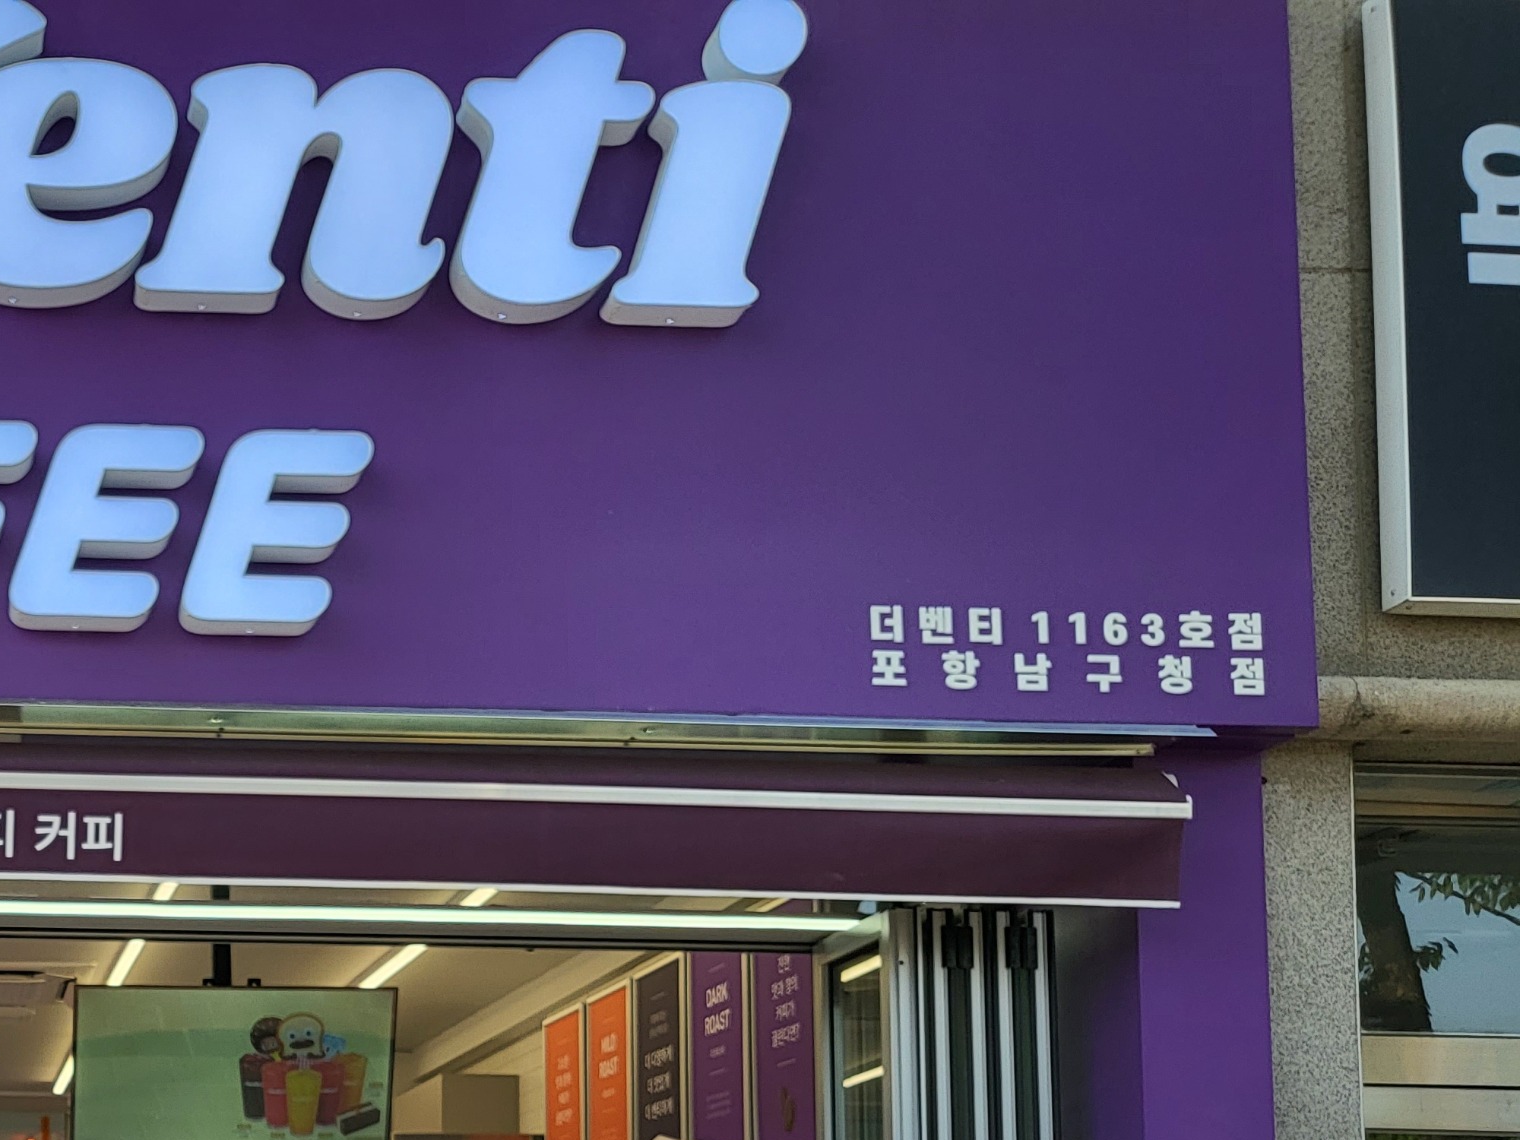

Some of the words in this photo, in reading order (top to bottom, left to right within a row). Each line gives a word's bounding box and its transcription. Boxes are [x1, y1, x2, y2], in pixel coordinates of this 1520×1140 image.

[869, 604, 1005, 646] 더벤티
[1030, 610, 1264, 652] 1163호점
[33, 809, 124, 862] 커피
[705, 981, 728, 1009] DARK
[704, 1008, 731, 1037] ROAST
[600, 1032, 619, 1055] MILD
[598, 1055, 620, 1080] ROAST
